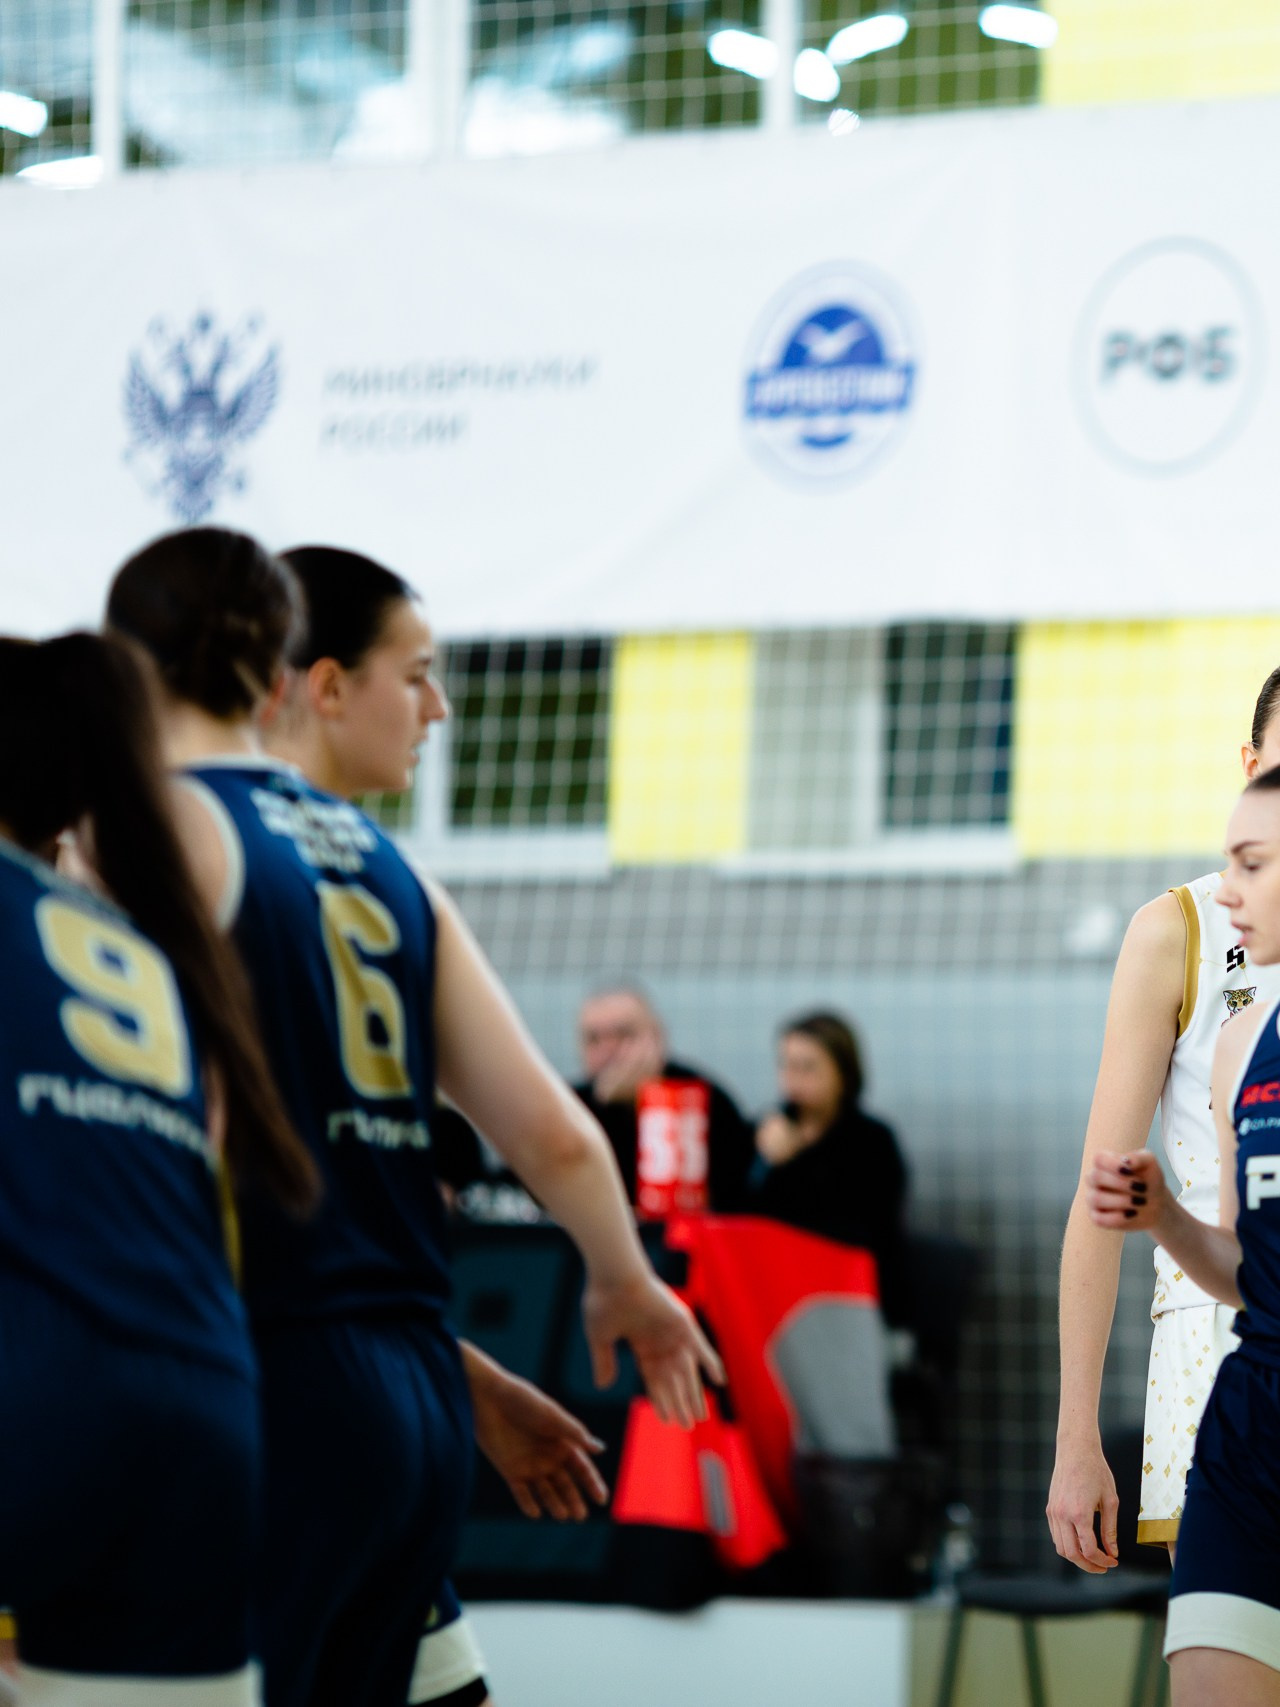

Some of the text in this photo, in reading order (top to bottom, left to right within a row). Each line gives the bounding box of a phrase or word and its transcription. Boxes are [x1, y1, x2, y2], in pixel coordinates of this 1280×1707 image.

[1102, 326, 1234, 386] РФБ
[35, 895, 192, 1098] 9
[318, 880, 412, 1098] 6
